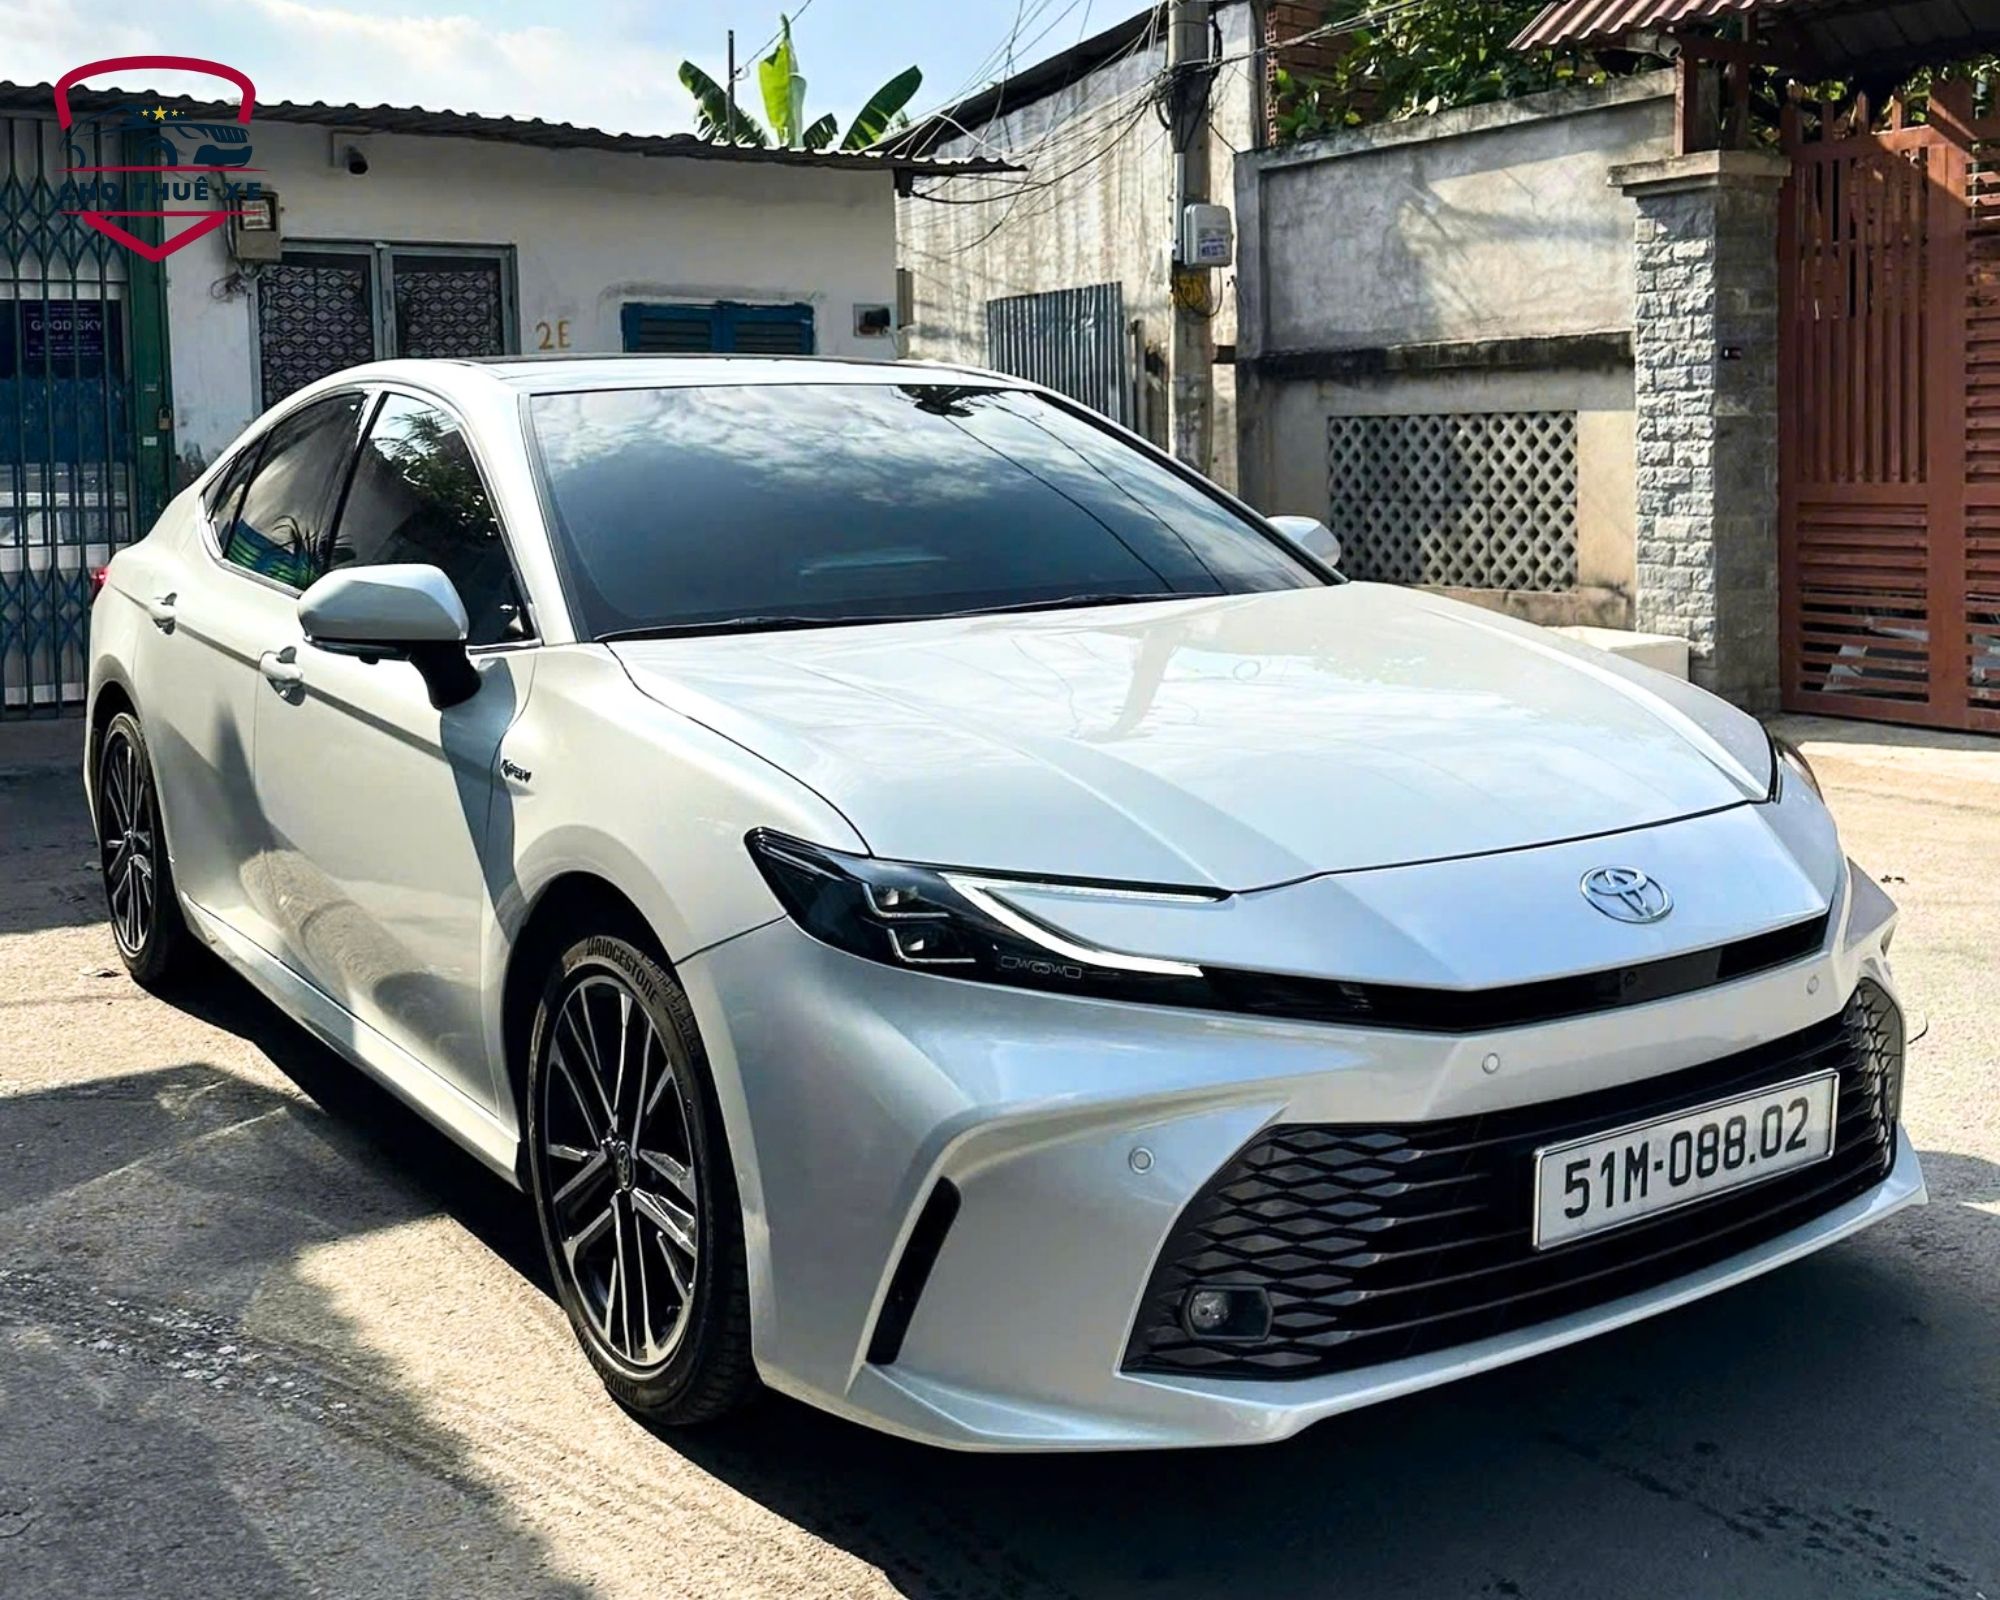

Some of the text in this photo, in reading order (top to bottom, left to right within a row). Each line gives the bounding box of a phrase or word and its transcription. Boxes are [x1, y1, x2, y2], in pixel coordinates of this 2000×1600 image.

[77, 319, 103, 332] SKY
[535, 320, 571, 350] 2E
[1564, 1096, 1809, 1219] 51M-088.02
